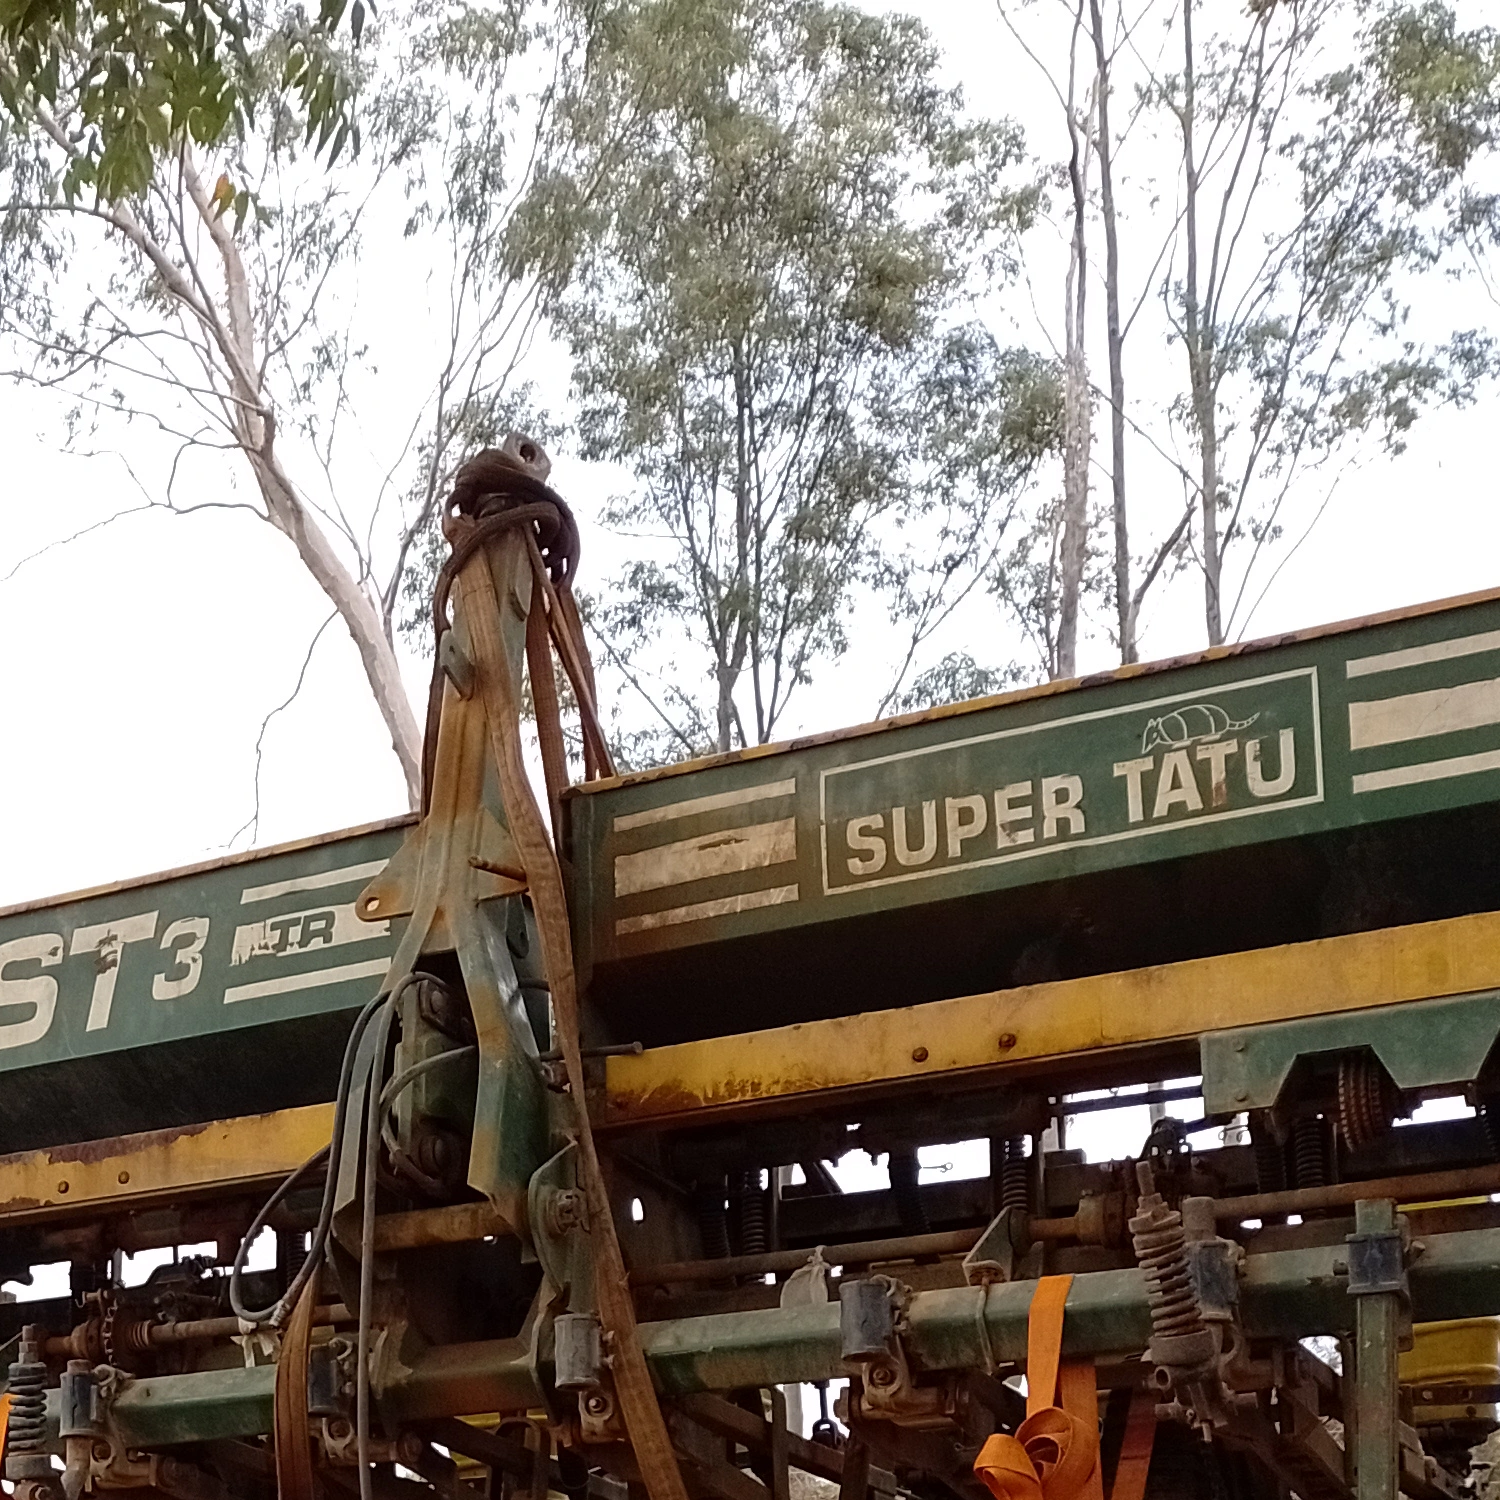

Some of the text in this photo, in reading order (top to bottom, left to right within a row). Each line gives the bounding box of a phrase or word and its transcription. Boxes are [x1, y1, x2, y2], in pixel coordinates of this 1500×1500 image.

[845, 727, 1297, 877] SUPER TATU
[152, 916, 211, 1001] 3
